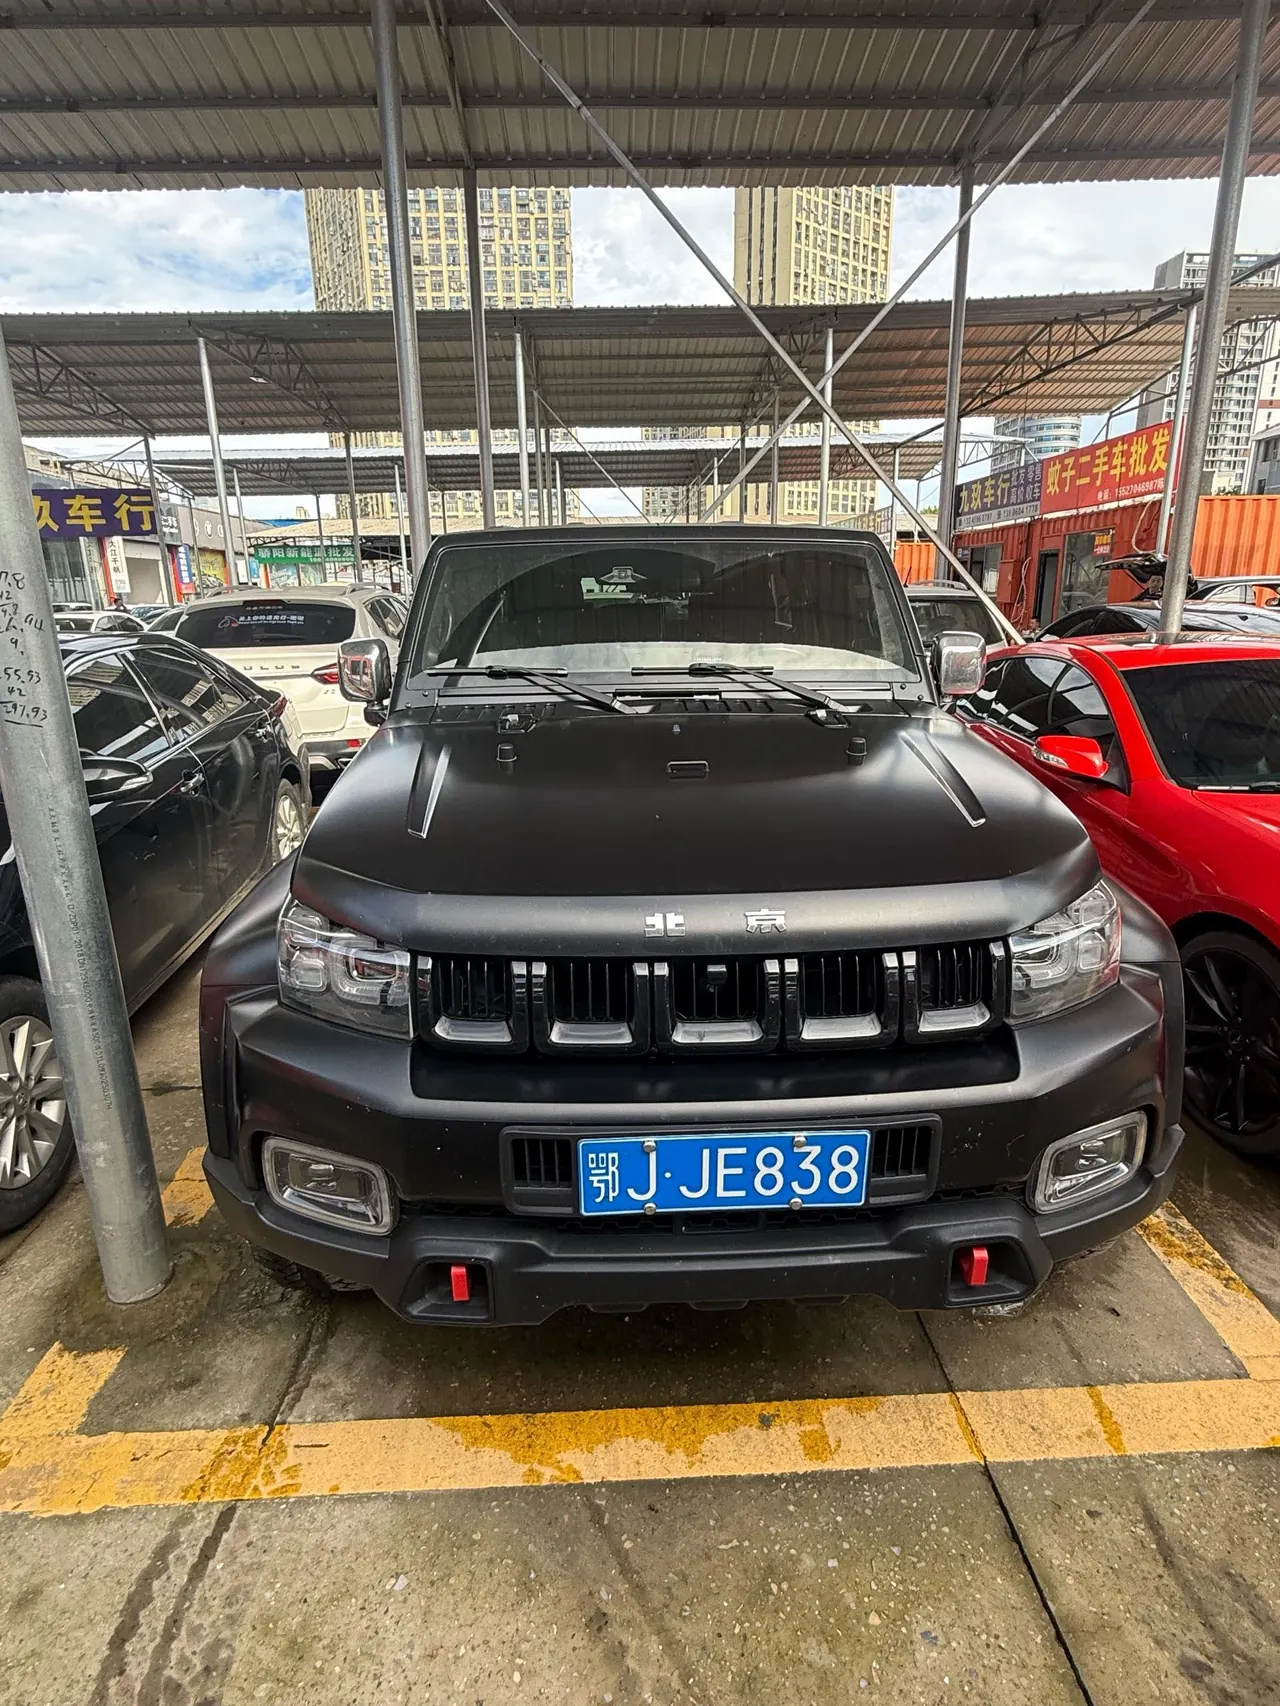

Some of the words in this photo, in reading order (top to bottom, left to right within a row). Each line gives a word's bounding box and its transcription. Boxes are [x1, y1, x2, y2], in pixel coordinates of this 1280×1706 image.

[1046, 427, 1170, 496] 蚊子二手车批发
[958, 473, 1010, 514] 九玖车行
[258, 547, 354, 558] 骄阳新能源批发
[645, 908, 787, 937] 北京
